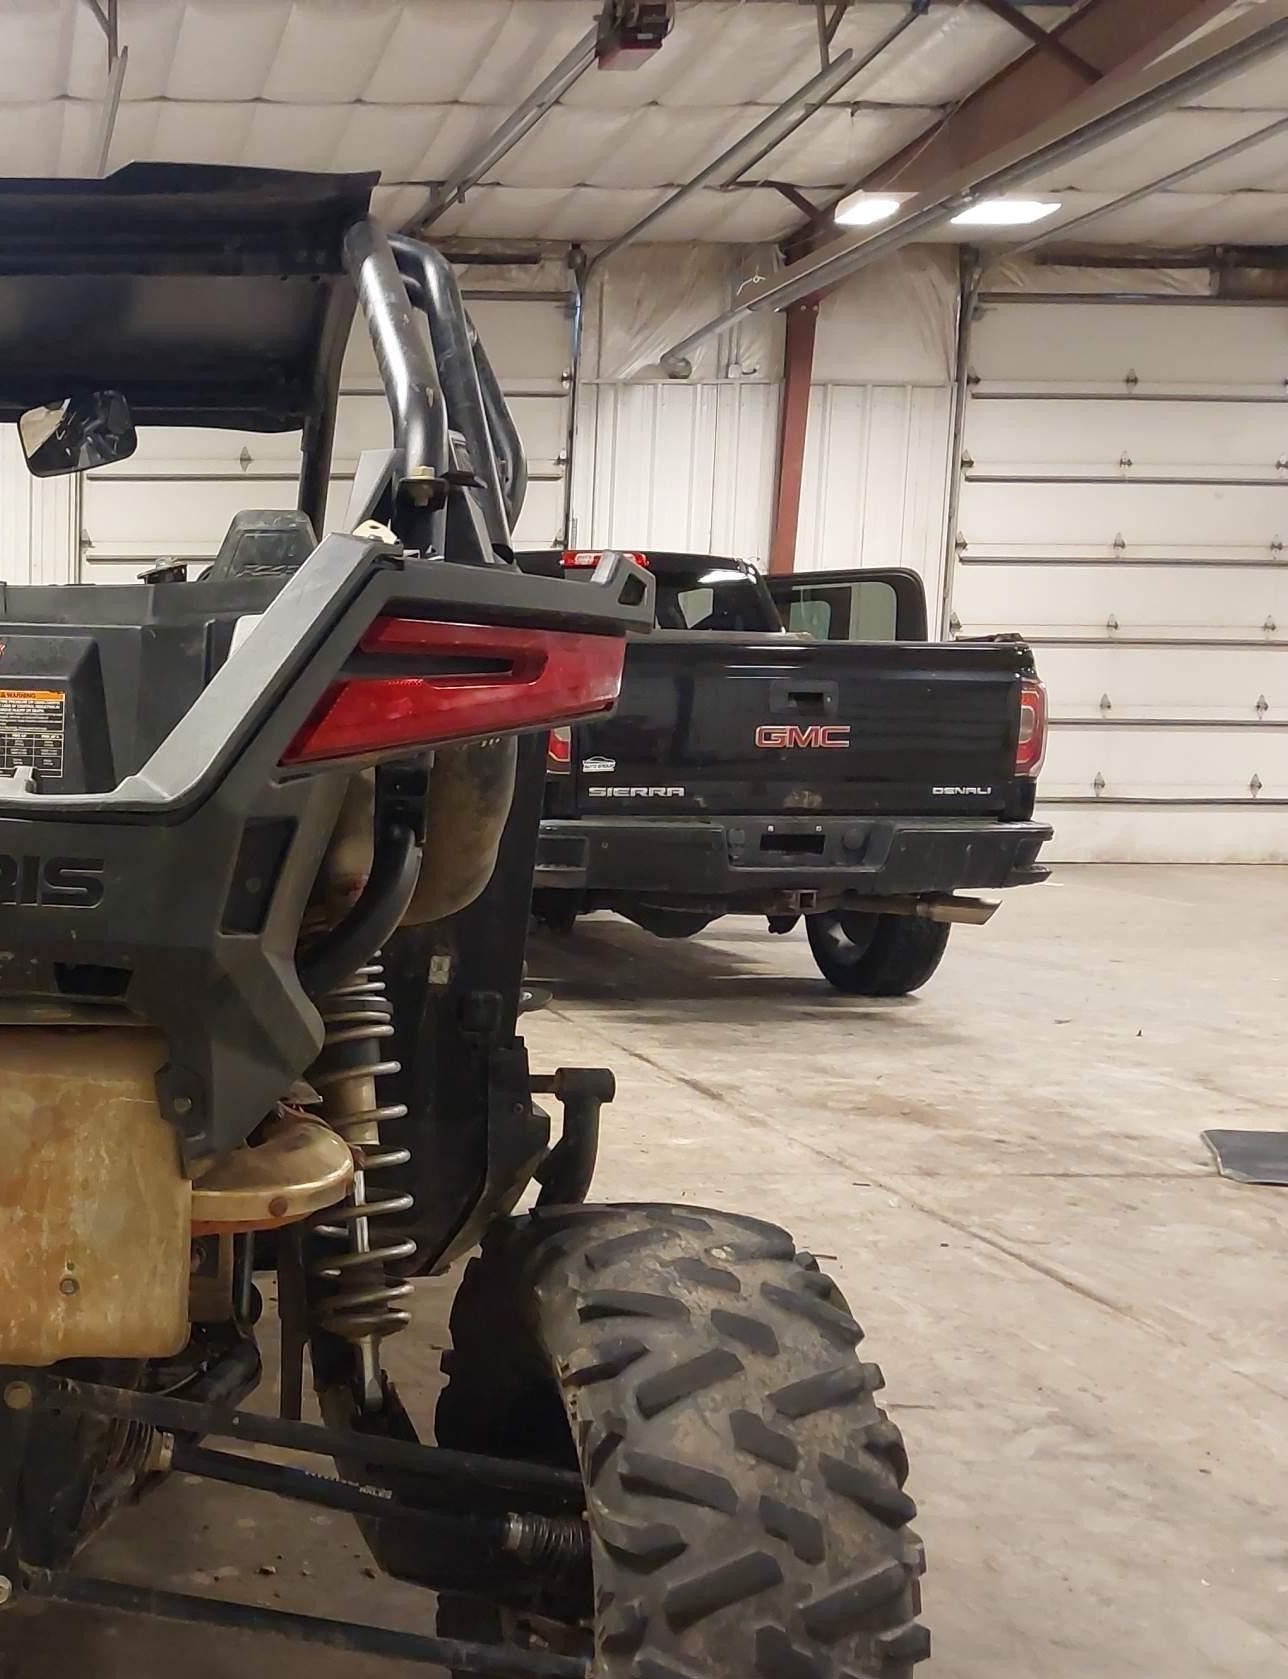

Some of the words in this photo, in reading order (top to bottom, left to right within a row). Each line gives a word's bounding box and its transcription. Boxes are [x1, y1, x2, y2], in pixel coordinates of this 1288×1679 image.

[755, 726, 851, 747] GMC
[588, 787, 685, 797] SIERRA
[932, 787, 992, 795] DENALI
